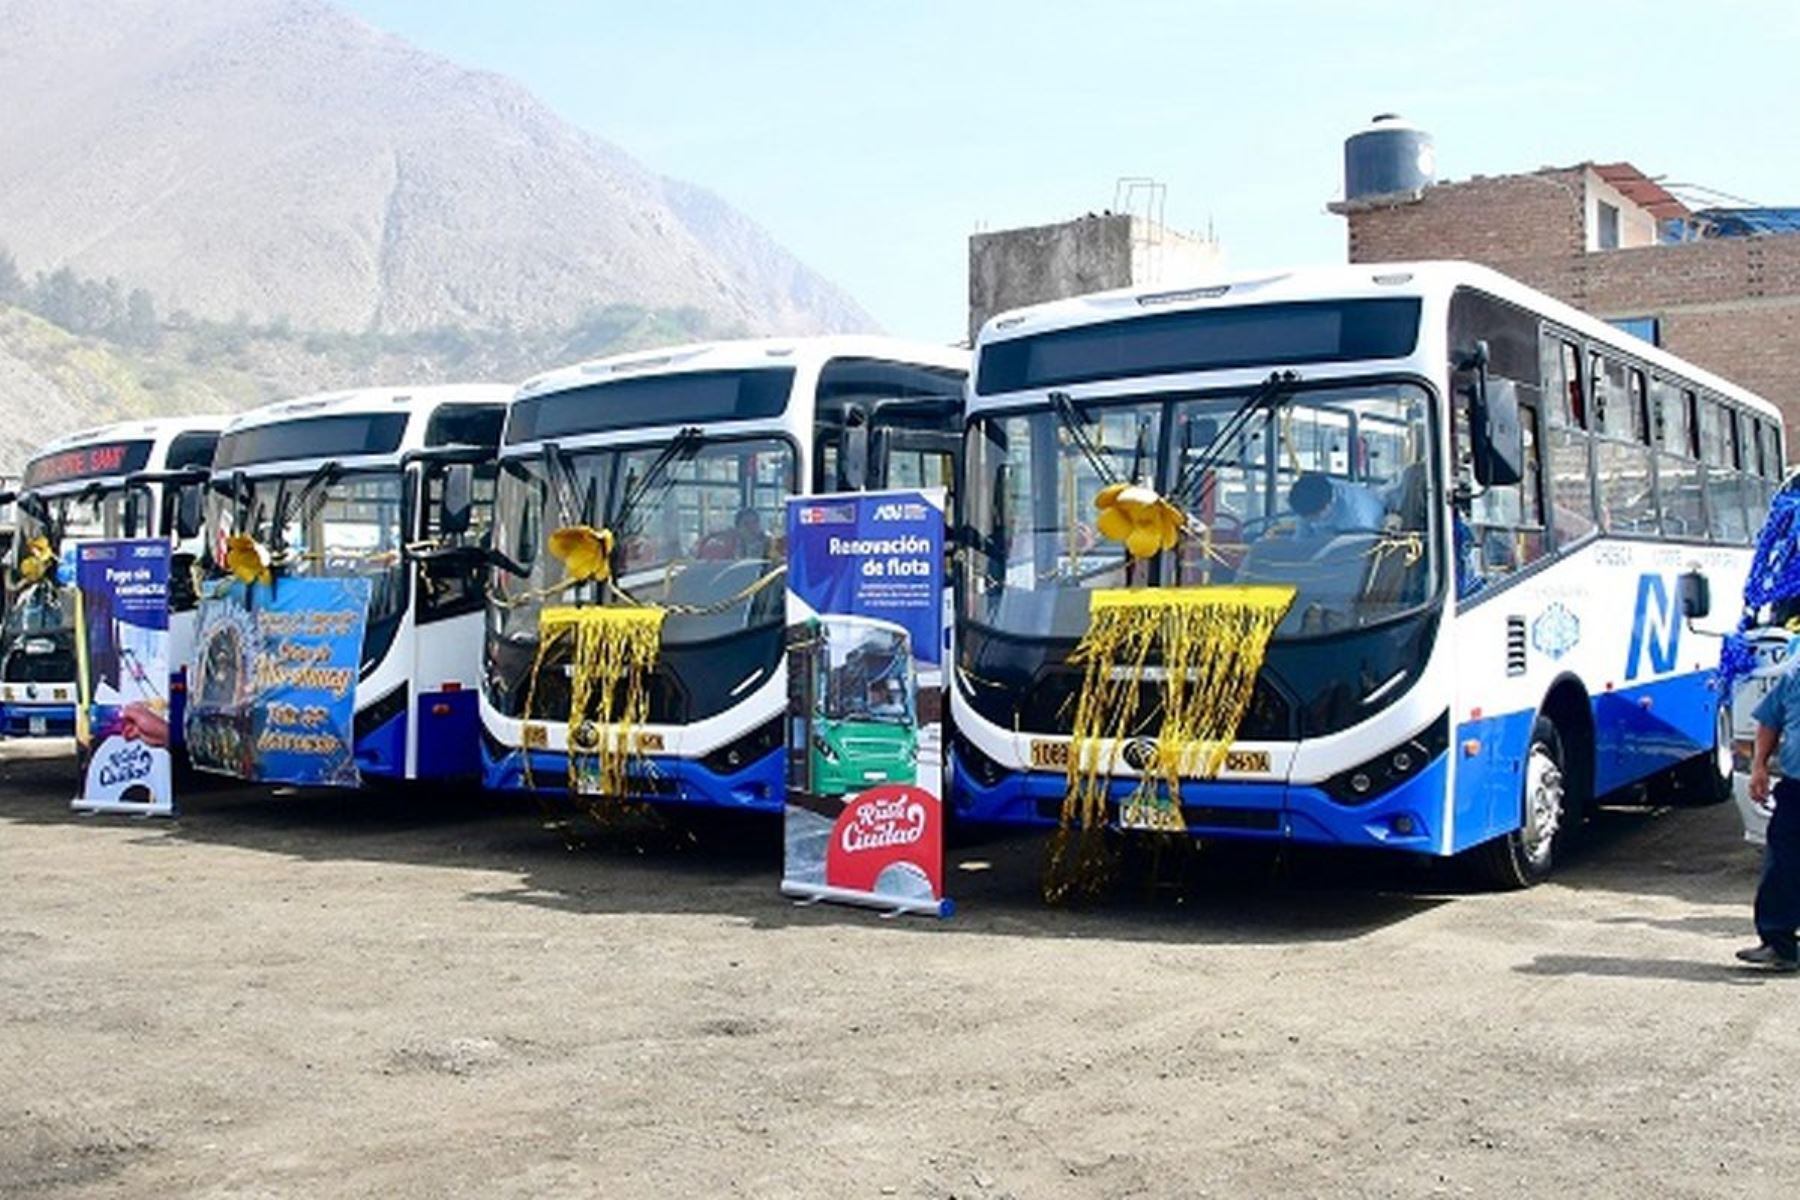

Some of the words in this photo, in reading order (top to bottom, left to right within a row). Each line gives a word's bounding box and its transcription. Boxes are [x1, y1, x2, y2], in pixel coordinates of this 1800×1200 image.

[829, 534, 930, 555] Renovación
[862, 558, 884, 576] de
[886, 556, 930, 576] flota
